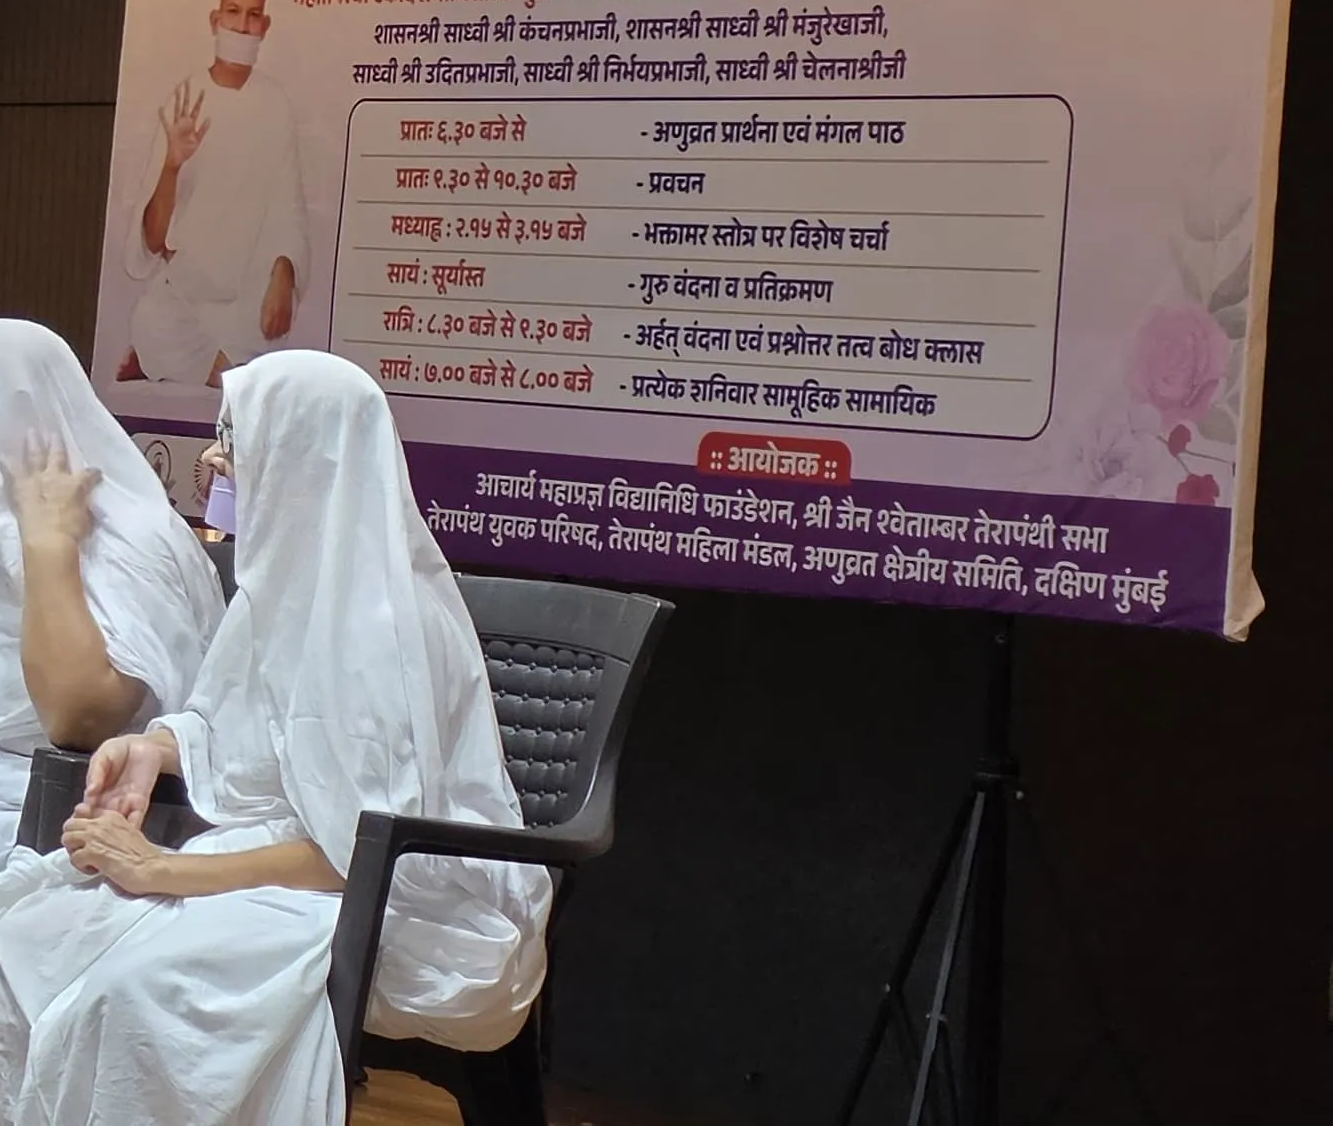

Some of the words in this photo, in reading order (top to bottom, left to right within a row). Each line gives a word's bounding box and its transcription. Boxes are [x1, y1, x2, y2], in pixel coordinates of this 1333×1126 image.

[374, 16, 439, 46] शासनश्री
[444, 14, 490, 43] साध्वी
[493, 14, 515, 43] श्री
[519, 12, 621, 44] कंचनप्रभाजी,
[626, 9, 701, 41] शासनश्री
[705, 8, 759, 38] साध्वी
[764, 7, 787, 37] श्री
[793, 4, 888, 46] मंजुरेखाजी,
[352, 58, 398, 85] साध्वी
[402, 57, 421, 84] श्री
[425, 55, 519, 86] उदितप्रभाजी,
[523, 55, 574, 83] साध्वी
[578, 54, 600, 83] श्री
[604, 53, 711, 85] निर्भयप्रभाजी,
[715, 51, 769, 82] साध्वी
[773, 50, 797, 82] श्री
[802, 48, 906, 81] चेलनाश्रीजी
[437, 121, 475, 145] ६.३०
[479, 114, 508, 142] बजे
[511, 114, 527, 142] से
[652, 121, 717, 153] अणुव्रत
[721, 113, 779, 144] प्रार्थना
[782, 114, 812, 144] एवं
[815, 114, 863, 144] मंगल
[868, 121, 906, 145] पाठ
[433, 170, 470, 194] ९.३०
[474, 162, 490, 190] से
[493, 170, 544, 195] १०.३०
[548, 162, 578, 192] बजे
[648, 172, 705, 195] प्रवचन
[455, 217, 493, 240] २.१५
[496, 211, 512, 240] से
[514, 218, 553, 244] ३.१५
[557, 213, 588, 242] बजे
[644, 222, 709, 247] भक्तामर
[712, 217, 757, 248] स्तोत्र
[761, 225, 786, 248] पर
[789, 219, 846, 251] विशेष
[849, 221, 890, 252] चर्चा
[387, 258, 421, 285] सायं
[431, 258, 486, 295] सूर्यास्त
[640, 273, 670, 304] गुरु
[674, 268, 721, 299] वंदना
[725, 276, 740, 299] व
[744, 271, 834, 303] प्रतिक्रमण
[383, 305, 415, 333] रात्रि
[426, 313, 465, 340] ८.३०
[469, 309, 498, 337] बजे
[500, 309, 517, 338] से
[519, 318, 558, 344] ९.३०
[562, 313, 593, 343] बजे
[636, 318, 680, 357] अर्हत्
[683, 320, 731, 351] वंदना
[736, 324, 764, 353] एवं
[767, 324, 833, 357] प्रश्नोत्तर
[836, 333, 875, 359] तत्व
[879, 328, 920, 361] बोध
[925, 339, 985, 364] क्लास
[380, 354, 412, 381] सायं
[423, 362, 465, 384] ७.००
[469, 357, 498, 387] बजे
[500, 359, 517, 388] से
[519, 368, 559, 390] ८.००
[563, 364, 594, 394] बजे
[632, 369, 687, 400] प्रत्येक
[690, 373, 759, 406] शनिवार
[762, 379, 842, 418] सामूहिक
[846, 384, 937, 417] सामायिक
[727, 442, 821, 476] आयोजक
[475, 469, 536, 501] आचार्य
[539, 478, 605, 511] महाप्रज्ञ
[608, 477, 699, 516] विद्यानिधि
[703, 488, 798, 529] फाउंडेशन,
[803, 495, 832, 529] श्री
[836, 495, 872, 533] जैन
[876, 502, 970, 543] श्वेताम्बर
[974, 509, 1056, 549] तेरापंथी
[1061, 524, 1109, 554] सभा
[427, 500, 486, 535] तेरापंथ
[489, 514, 536, 547] युवक
[540, 512, 603, 551] परिषद,
[608, 518, 674, 556] तेरापंथ
[676, 528, 739, 563] महिला
[743, 532, 797, 573] मंडल,
[802, 545, 879, 585] अणुव्रत
[883, 544, 948, 585] क्षेत्रीय
[952, 555, 1029, 597] समिति,
[1034, 561, 1108, 600] दक्षिण
[1111, 567, 1169, 614] मुंबई
